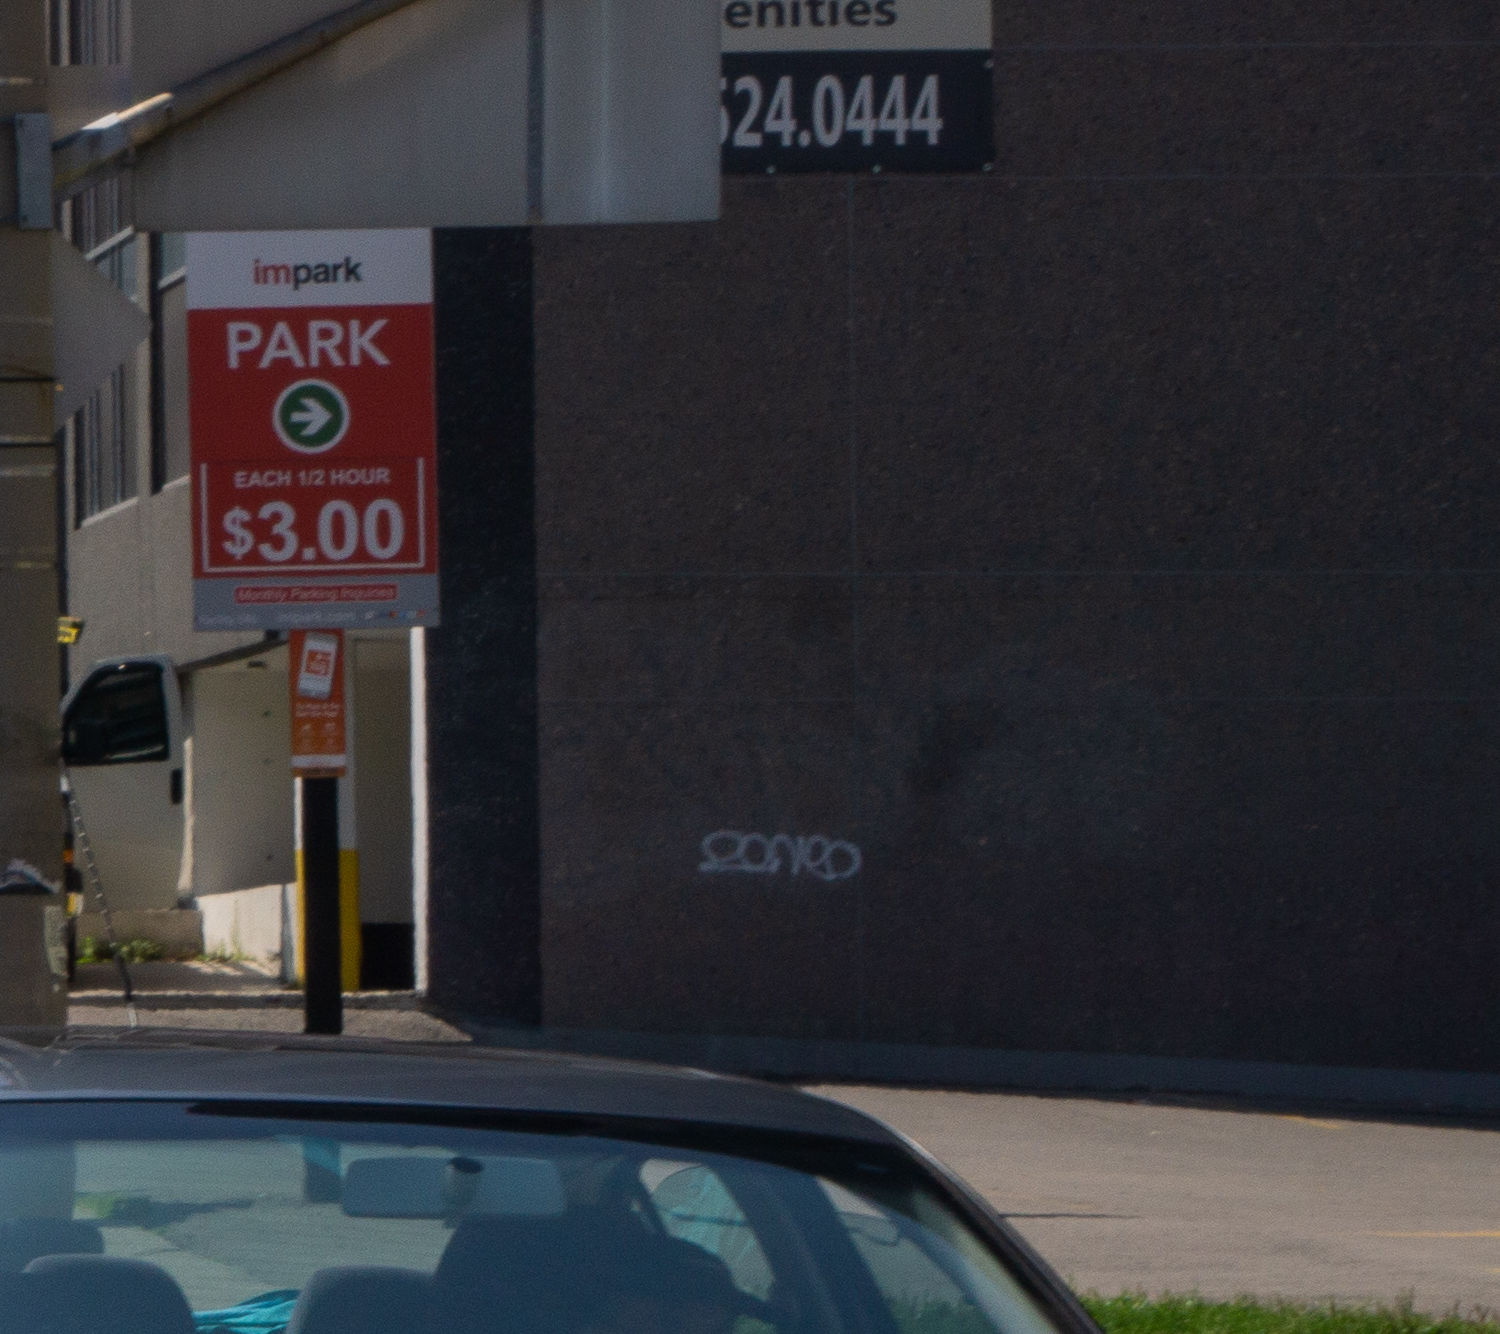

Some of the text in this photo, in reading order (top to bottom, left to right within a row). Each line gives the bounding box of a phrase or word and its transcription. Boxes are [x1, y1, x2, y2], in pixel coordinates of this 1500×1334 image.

[252, 257, 363, 290] impark
[226, 318, 391, 369] PARK
[234, 467, 391, 489] EACH 1/2 HOUR
[221, 497, 403, 563] $3.00
